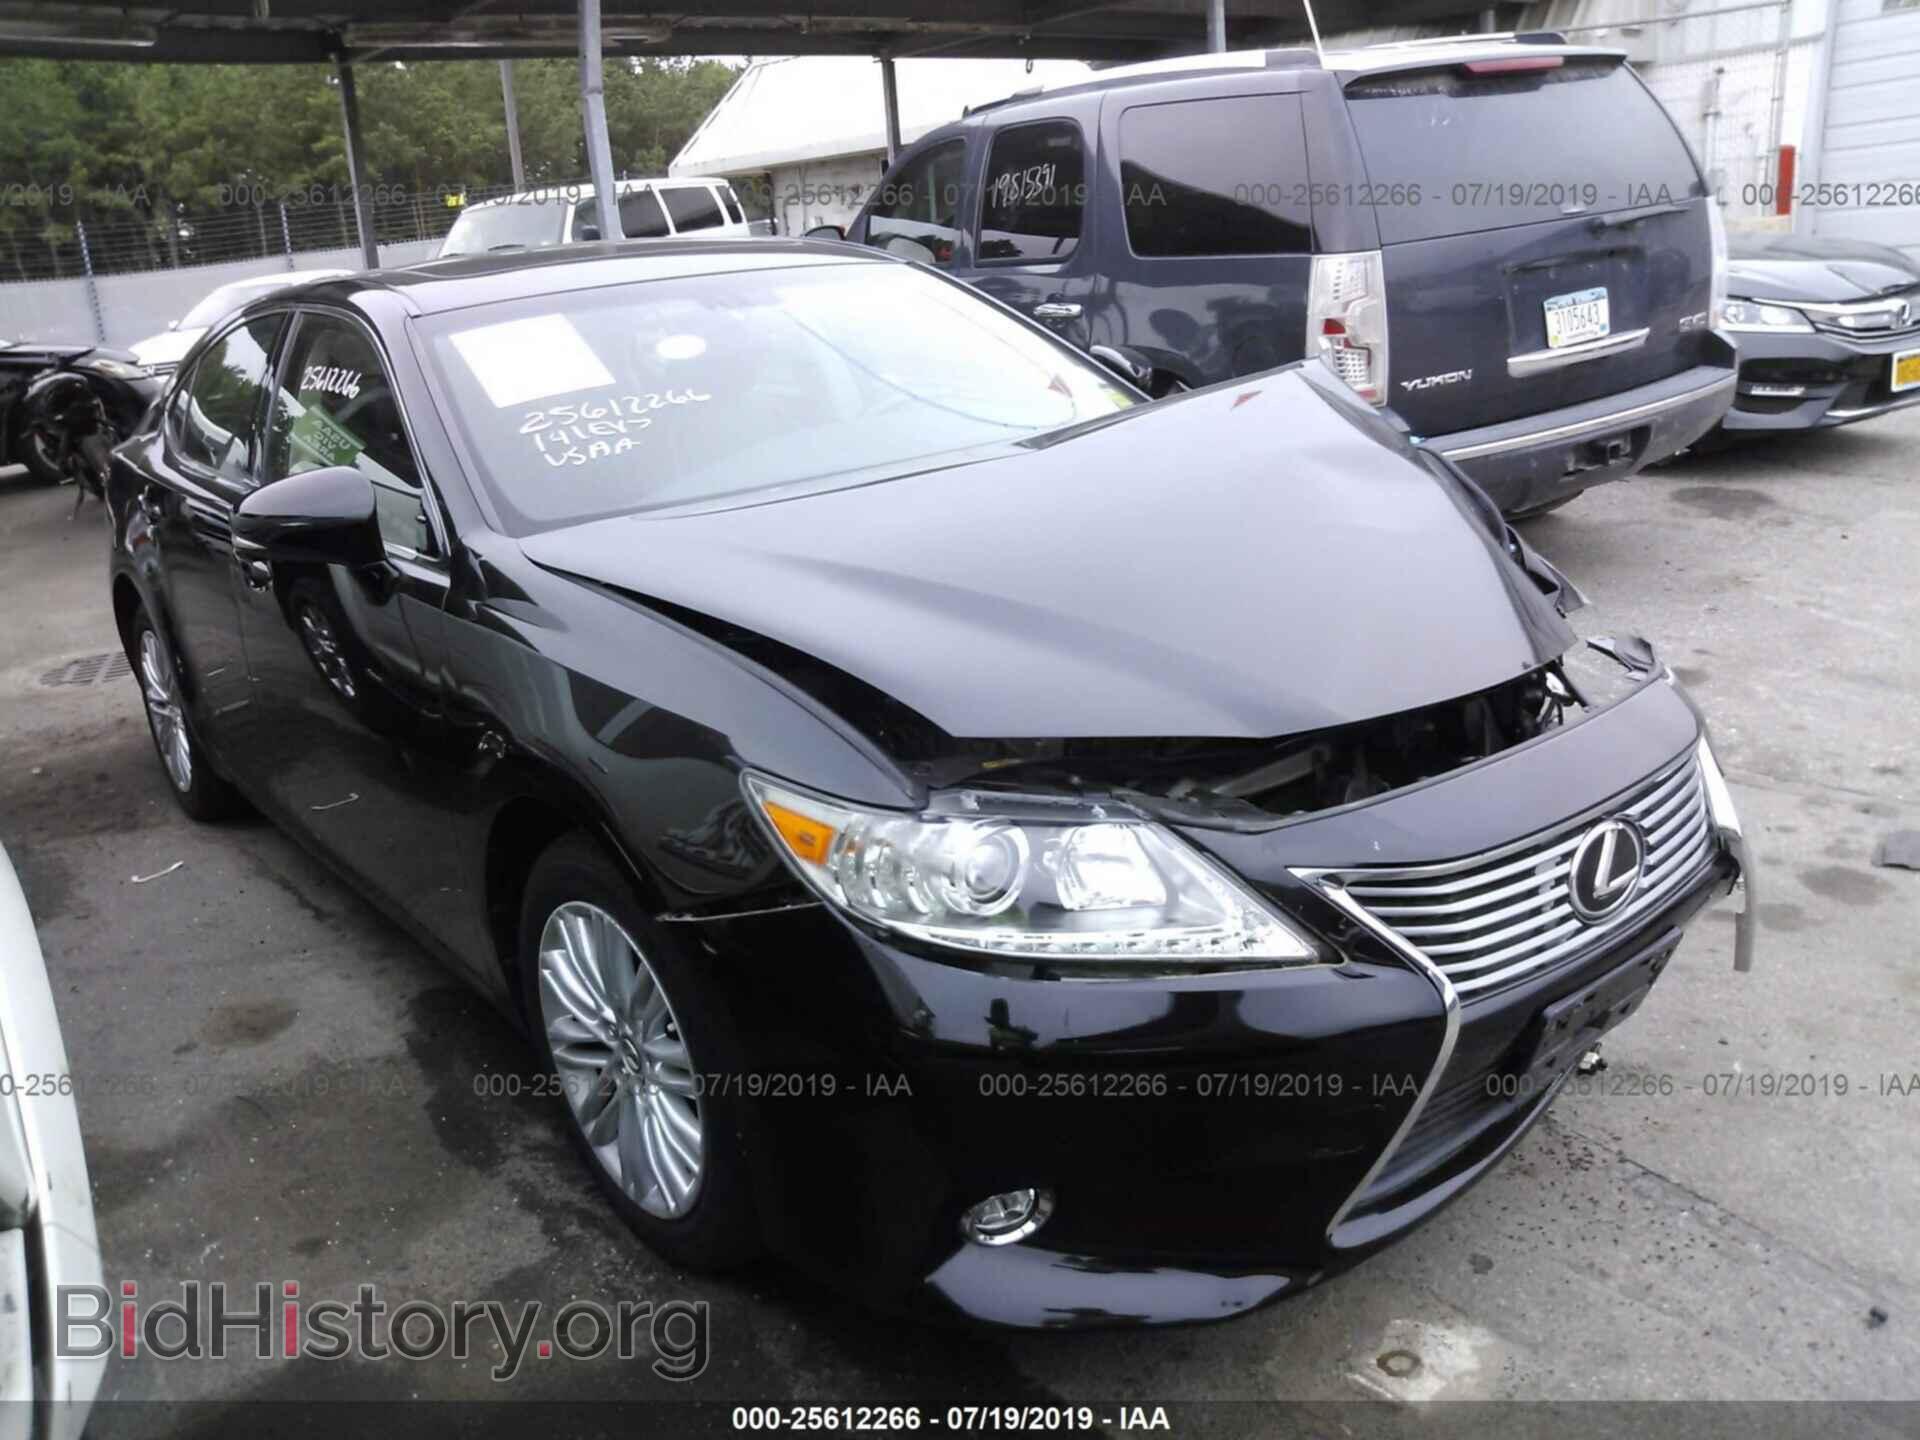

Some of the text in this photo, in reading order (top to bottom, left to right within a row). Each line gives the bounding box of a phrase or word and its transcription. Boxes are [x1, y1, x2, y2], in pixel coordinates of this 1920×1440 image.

[1400, 368, 1473, 392] YUKON
[520, 388, 712, 434] 25612266
[543, 437, 641, 466] USAA
